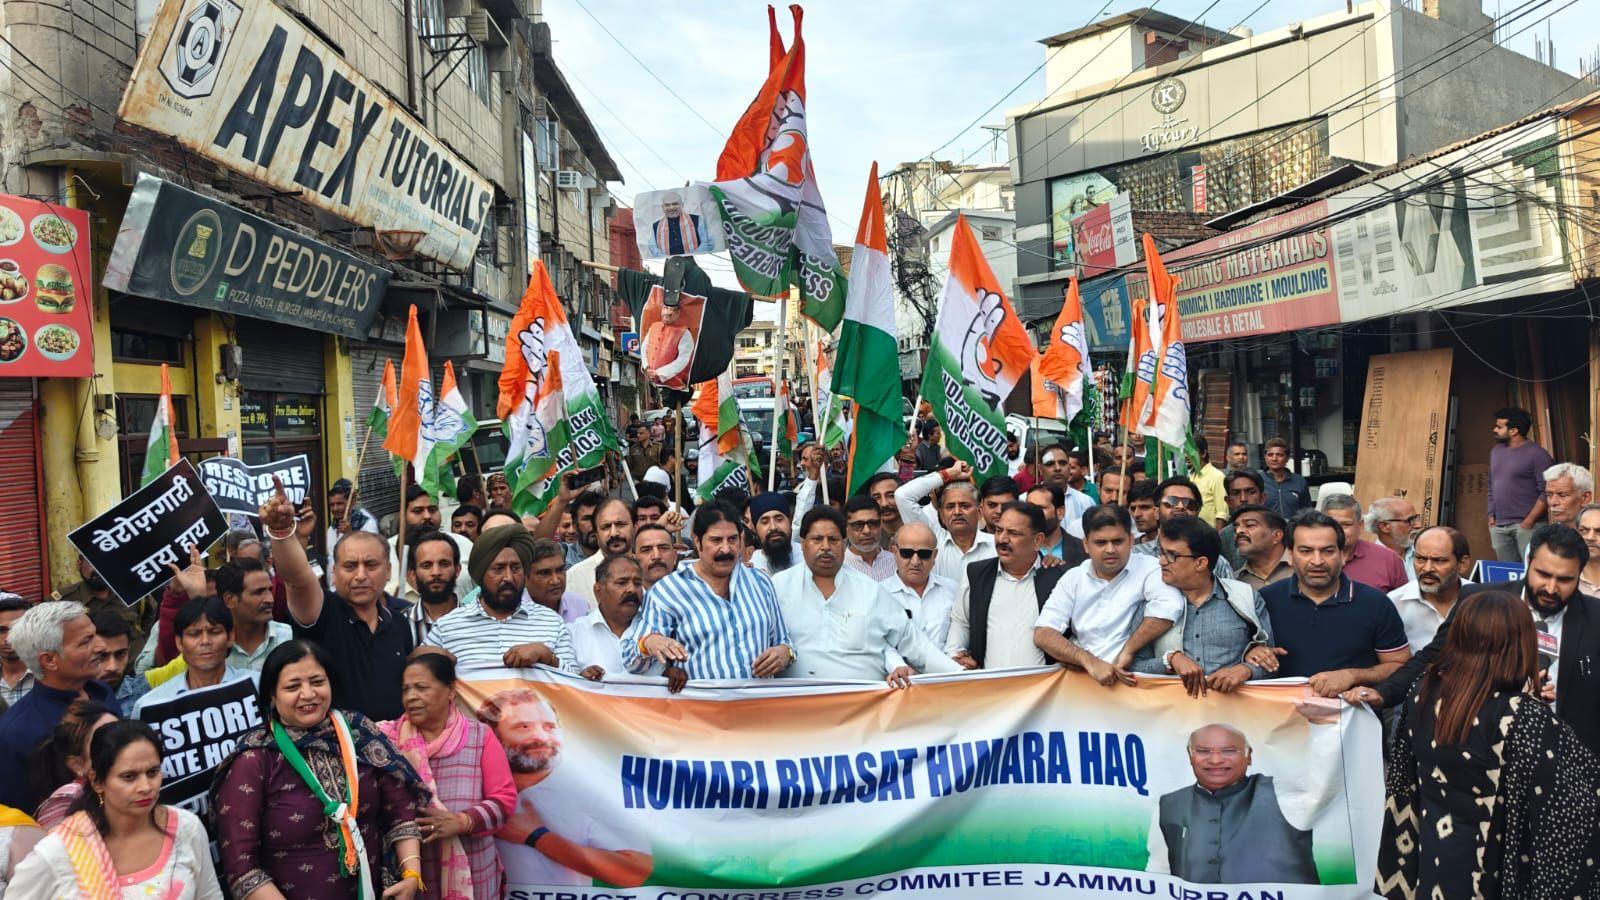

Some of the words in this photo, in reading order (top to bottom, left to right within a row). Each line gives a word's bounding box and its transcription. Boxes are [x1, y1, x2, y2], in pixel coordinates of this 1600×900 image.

[1160, 86, 1174, 105] K
[213, 24, 383, 206] APEX
[379, 117, 491, 236] TUTORIALS
[1140, 124, 1200, 152] Luxury
[223, 223, 257, 277] D
[257, 235, 377, 313] PEDDLERS
[1226, 229, 1328, 281] MATERIALS
[228, 289, 250, 305] PIZZA
[254, 295, 274, 310] PASTA
[1177, 294, 1209, 318] UNMICA
[1214, 281, 1264, 311] HARDWARE
[1271, 266, 1328, 299] MOULDING
[1181, 316, 1222, 340] HOLESALE
[1223, 316, 1231, 335] &
[1231, 310, 1265, 333] RETAIL
[205, 478, 255, 506] STATE
[91, 474, 195, 552] बेरोज़गारी
[130, 542, 179, 583] हाय
[148, 695, 263, 751] STORE
[160, 748, 202, 780] ATE
[621, 754, 769, 810] HUMARI
[777, 747, 919, 808] RIYASAT
[926, 731, 1072, 798] HUMARA
[1078, 731, 1149, 796] HAQ
[855, 870, 1024, 895] COMMITEE
[1034, 870, 1157, 895] JAMMU
